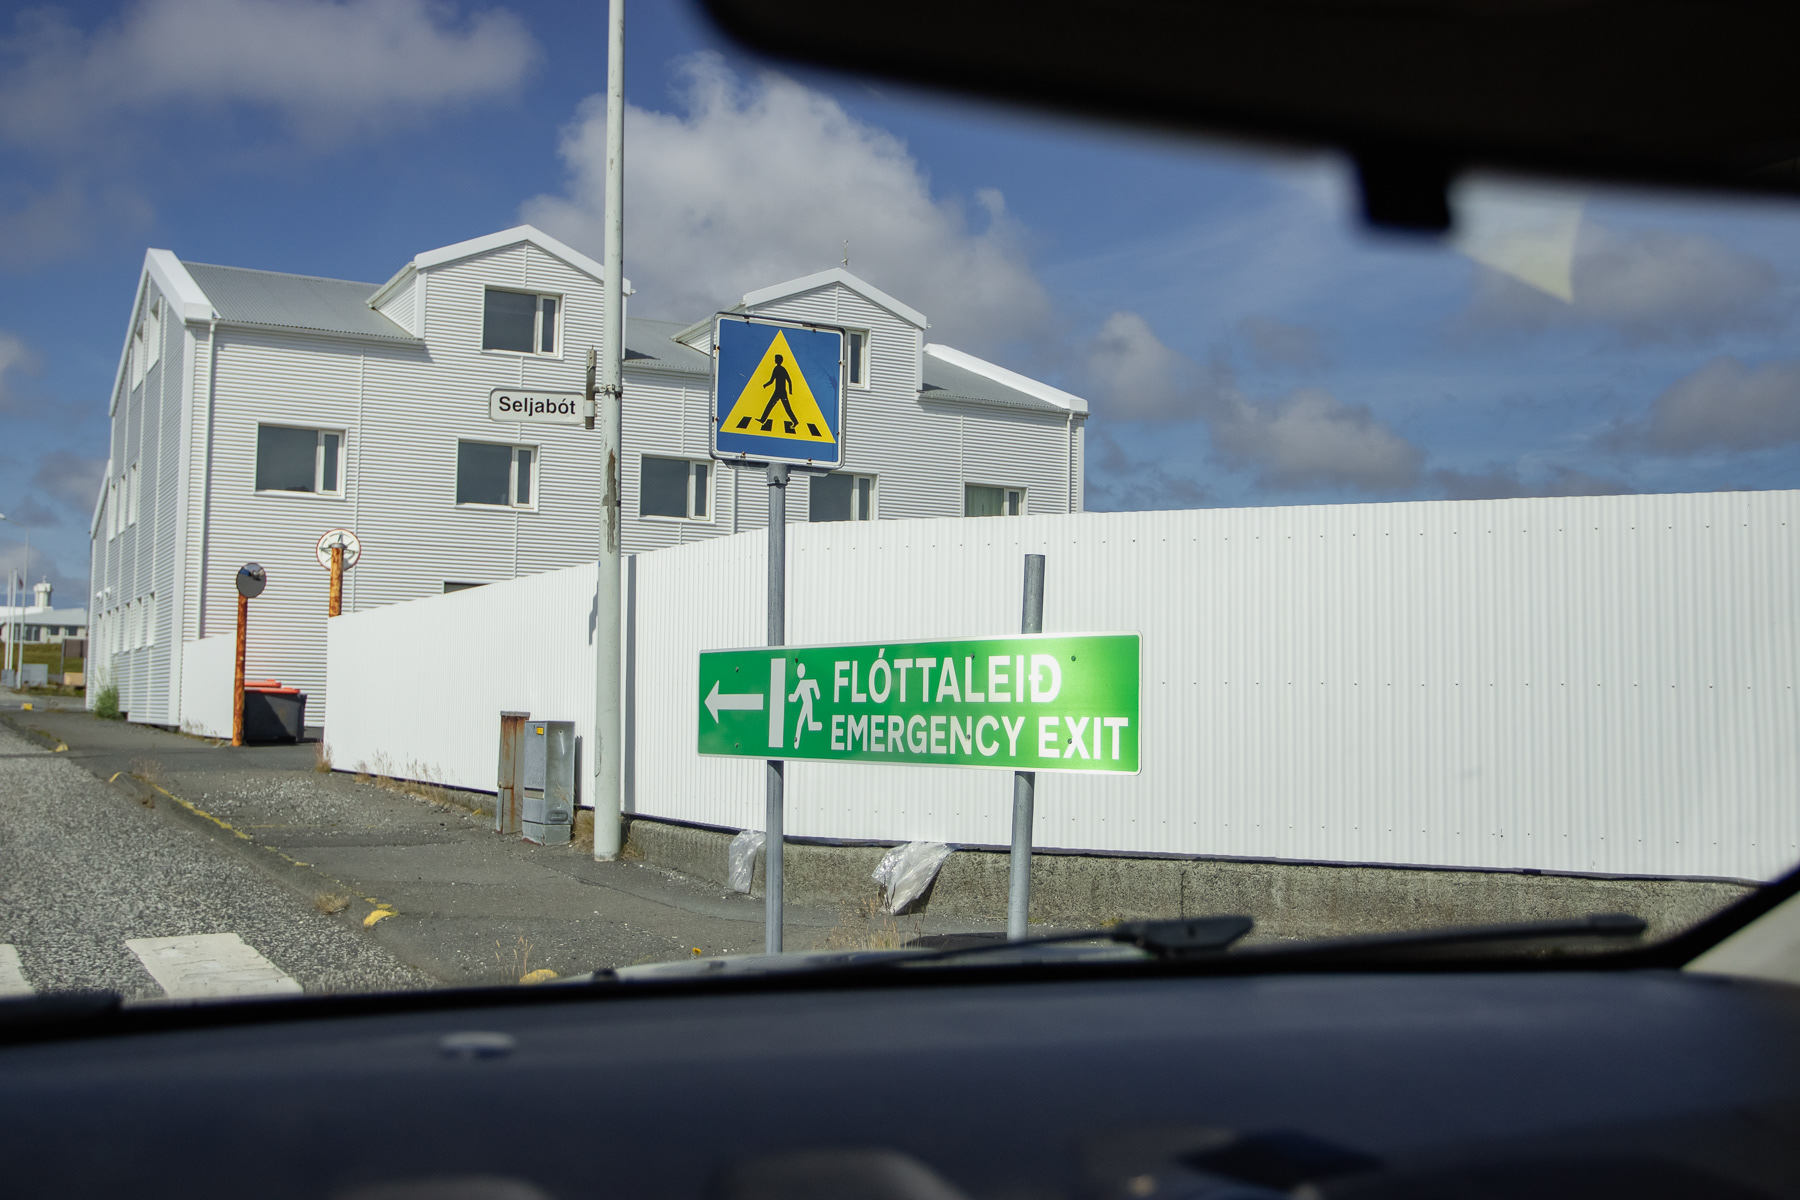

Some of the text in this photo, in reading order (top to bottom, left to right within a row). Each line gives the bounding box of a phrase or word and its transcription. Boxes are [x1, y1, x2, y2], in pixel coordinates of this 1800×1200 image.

[499, 396, 576, 417] Seljabót
[833, 648, 1062, 705] FLÓTTALEIÐ
[830, 714, 1129, 760] EMERGENCY EXIT
